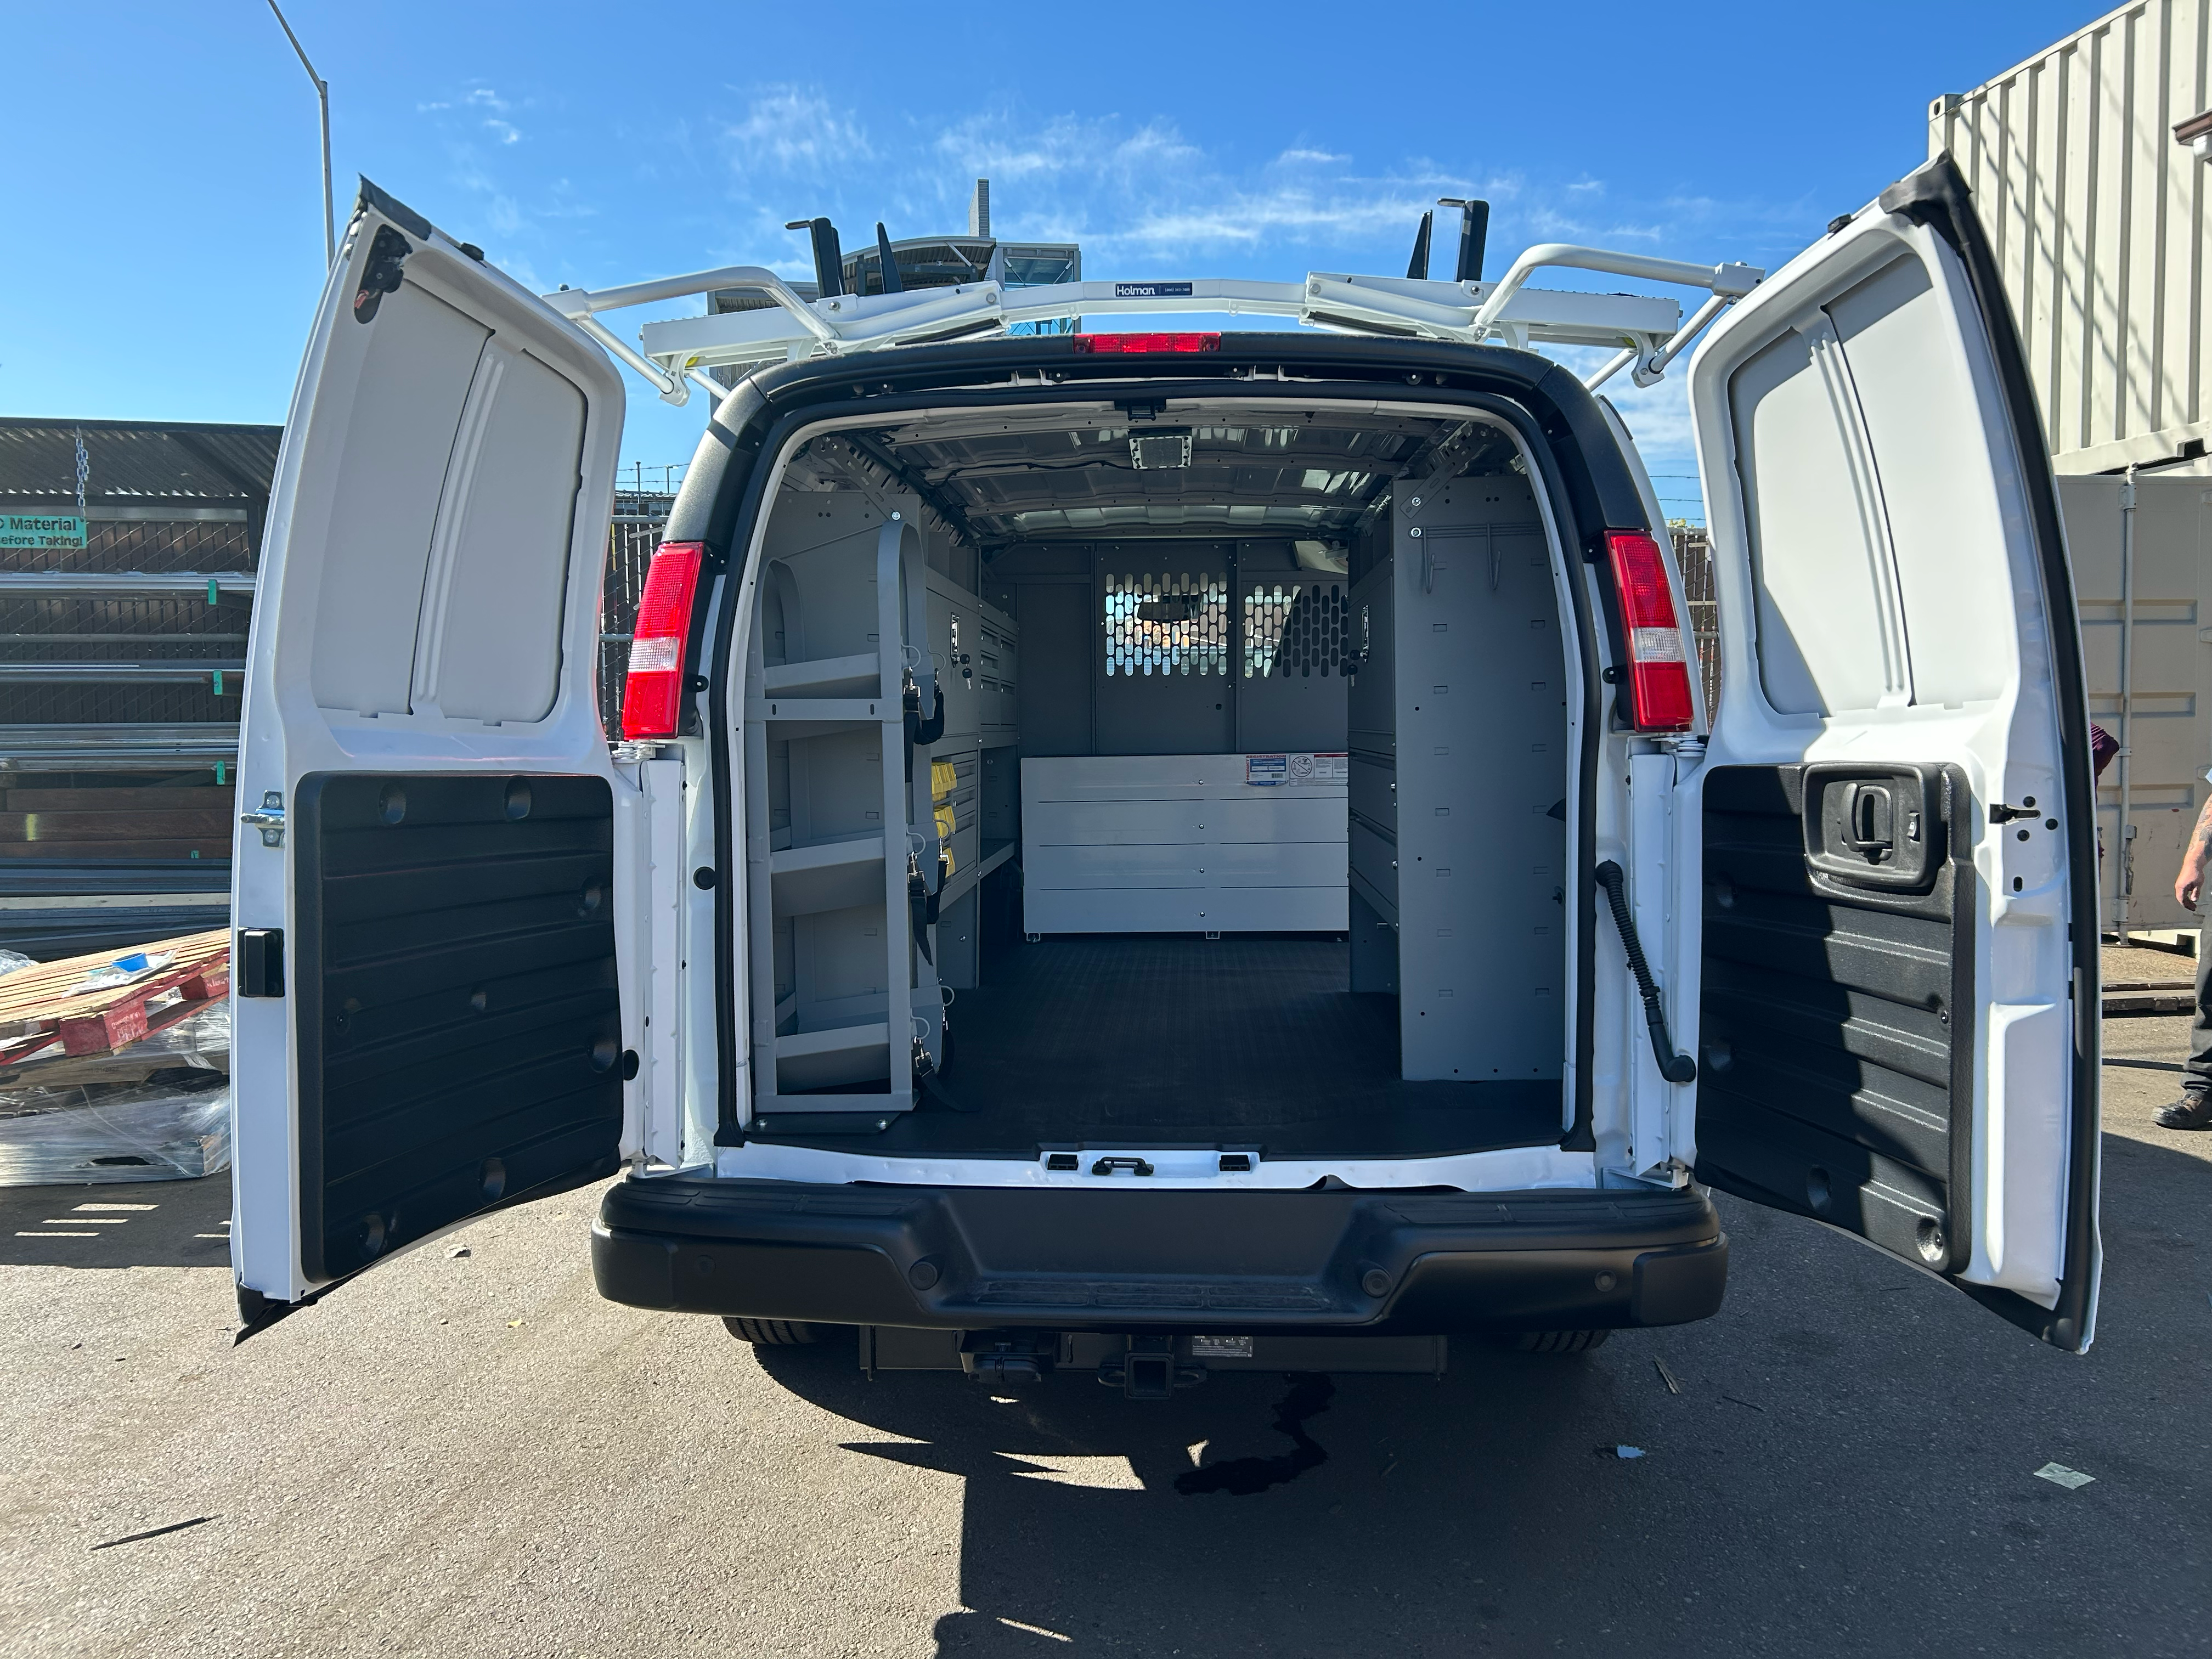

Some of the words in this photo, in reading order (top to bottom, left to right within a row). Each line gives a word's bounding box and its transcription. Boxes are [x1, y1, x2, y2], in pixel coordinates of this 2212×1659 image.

[1117, 285, 1155, 296] Holman
[10, 517, 76, 531] Material
[0, 535, 35, 545] efore
[38, 535, 83, 547] Taking!
